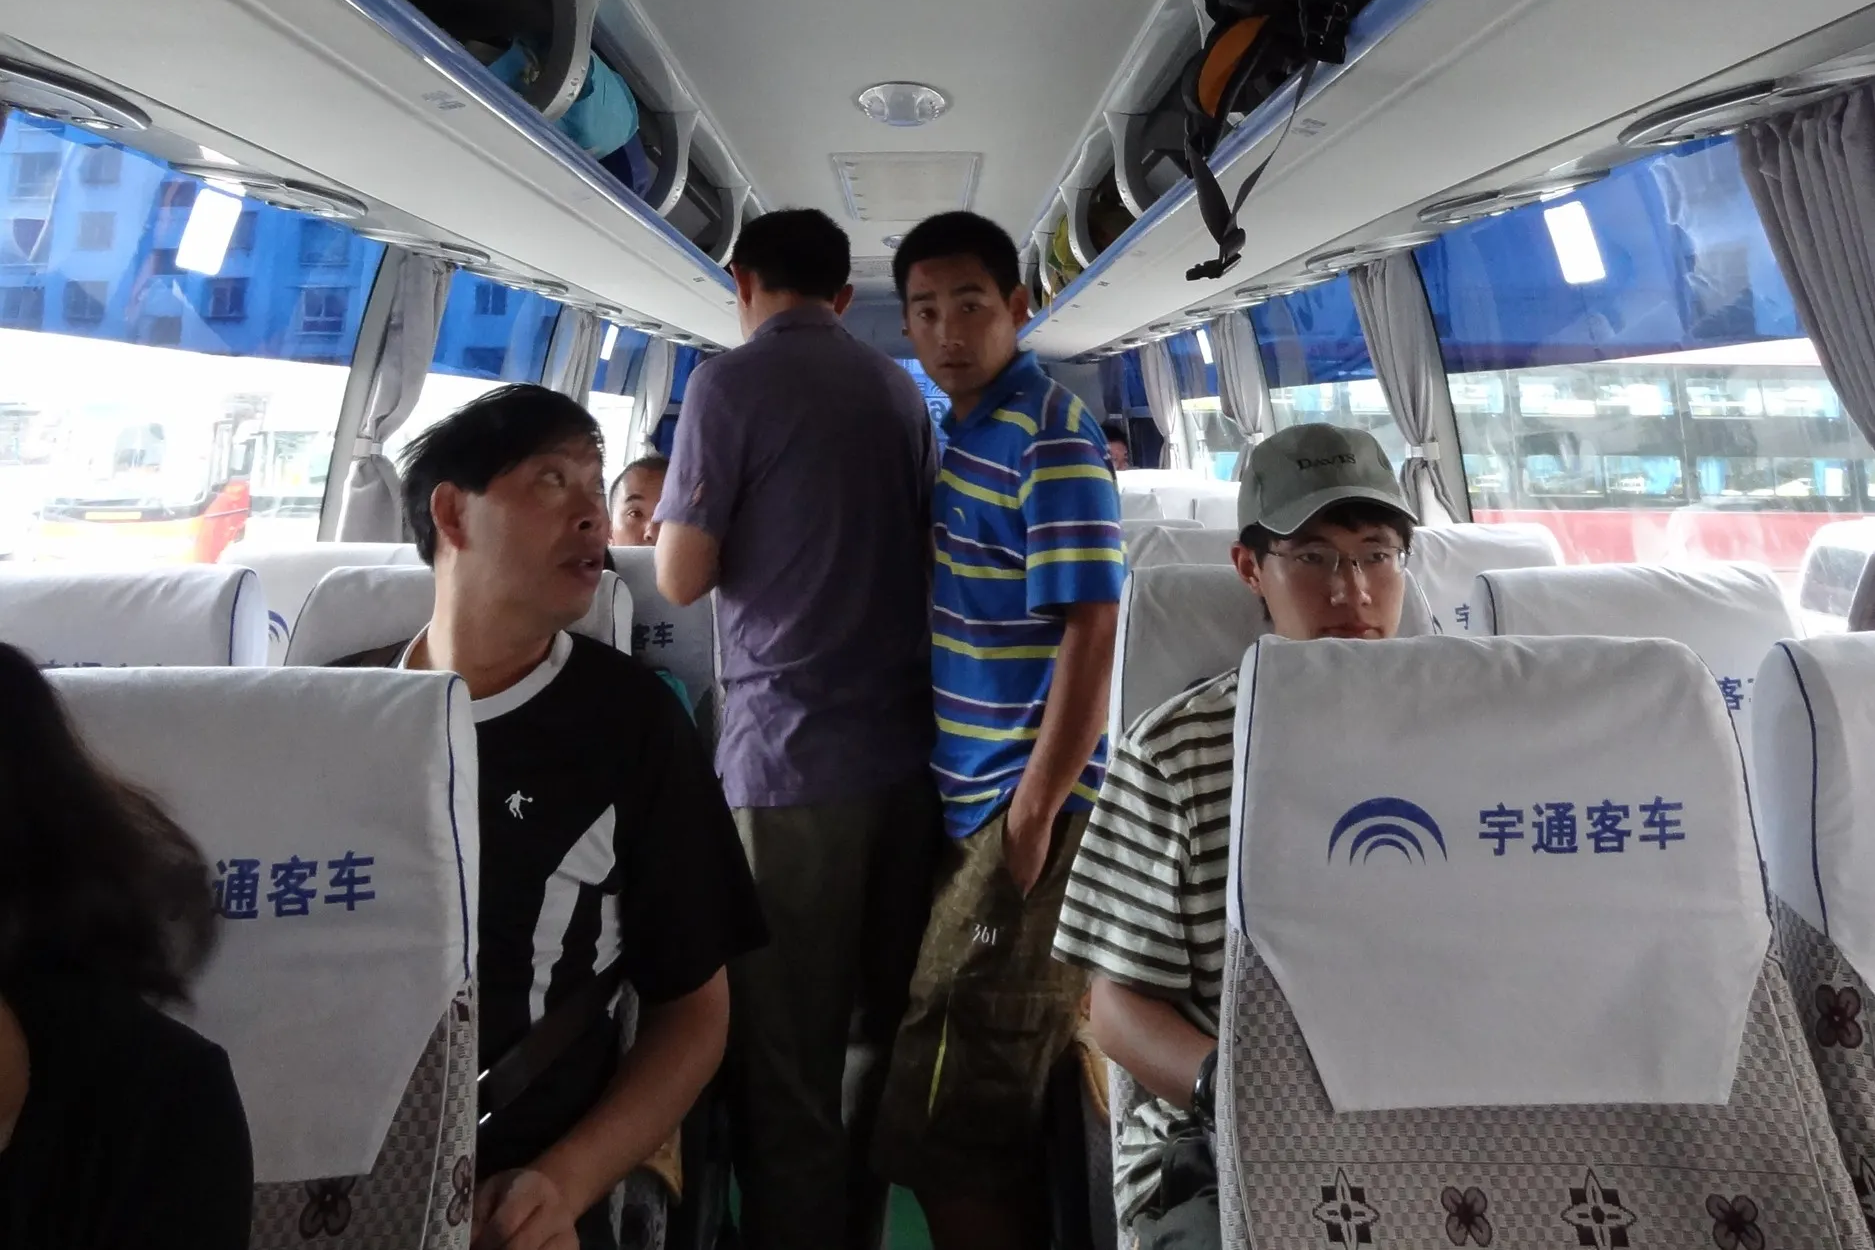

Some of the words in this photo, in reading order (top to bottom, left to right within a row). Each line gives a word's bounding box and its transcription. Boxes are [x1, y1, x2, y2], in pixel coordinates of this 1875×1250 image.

[1717, 676, 1754, 710] 客
[1479, 795, 1686, 856] 宇通客车
[212, 849, 375, 919] 通客车
